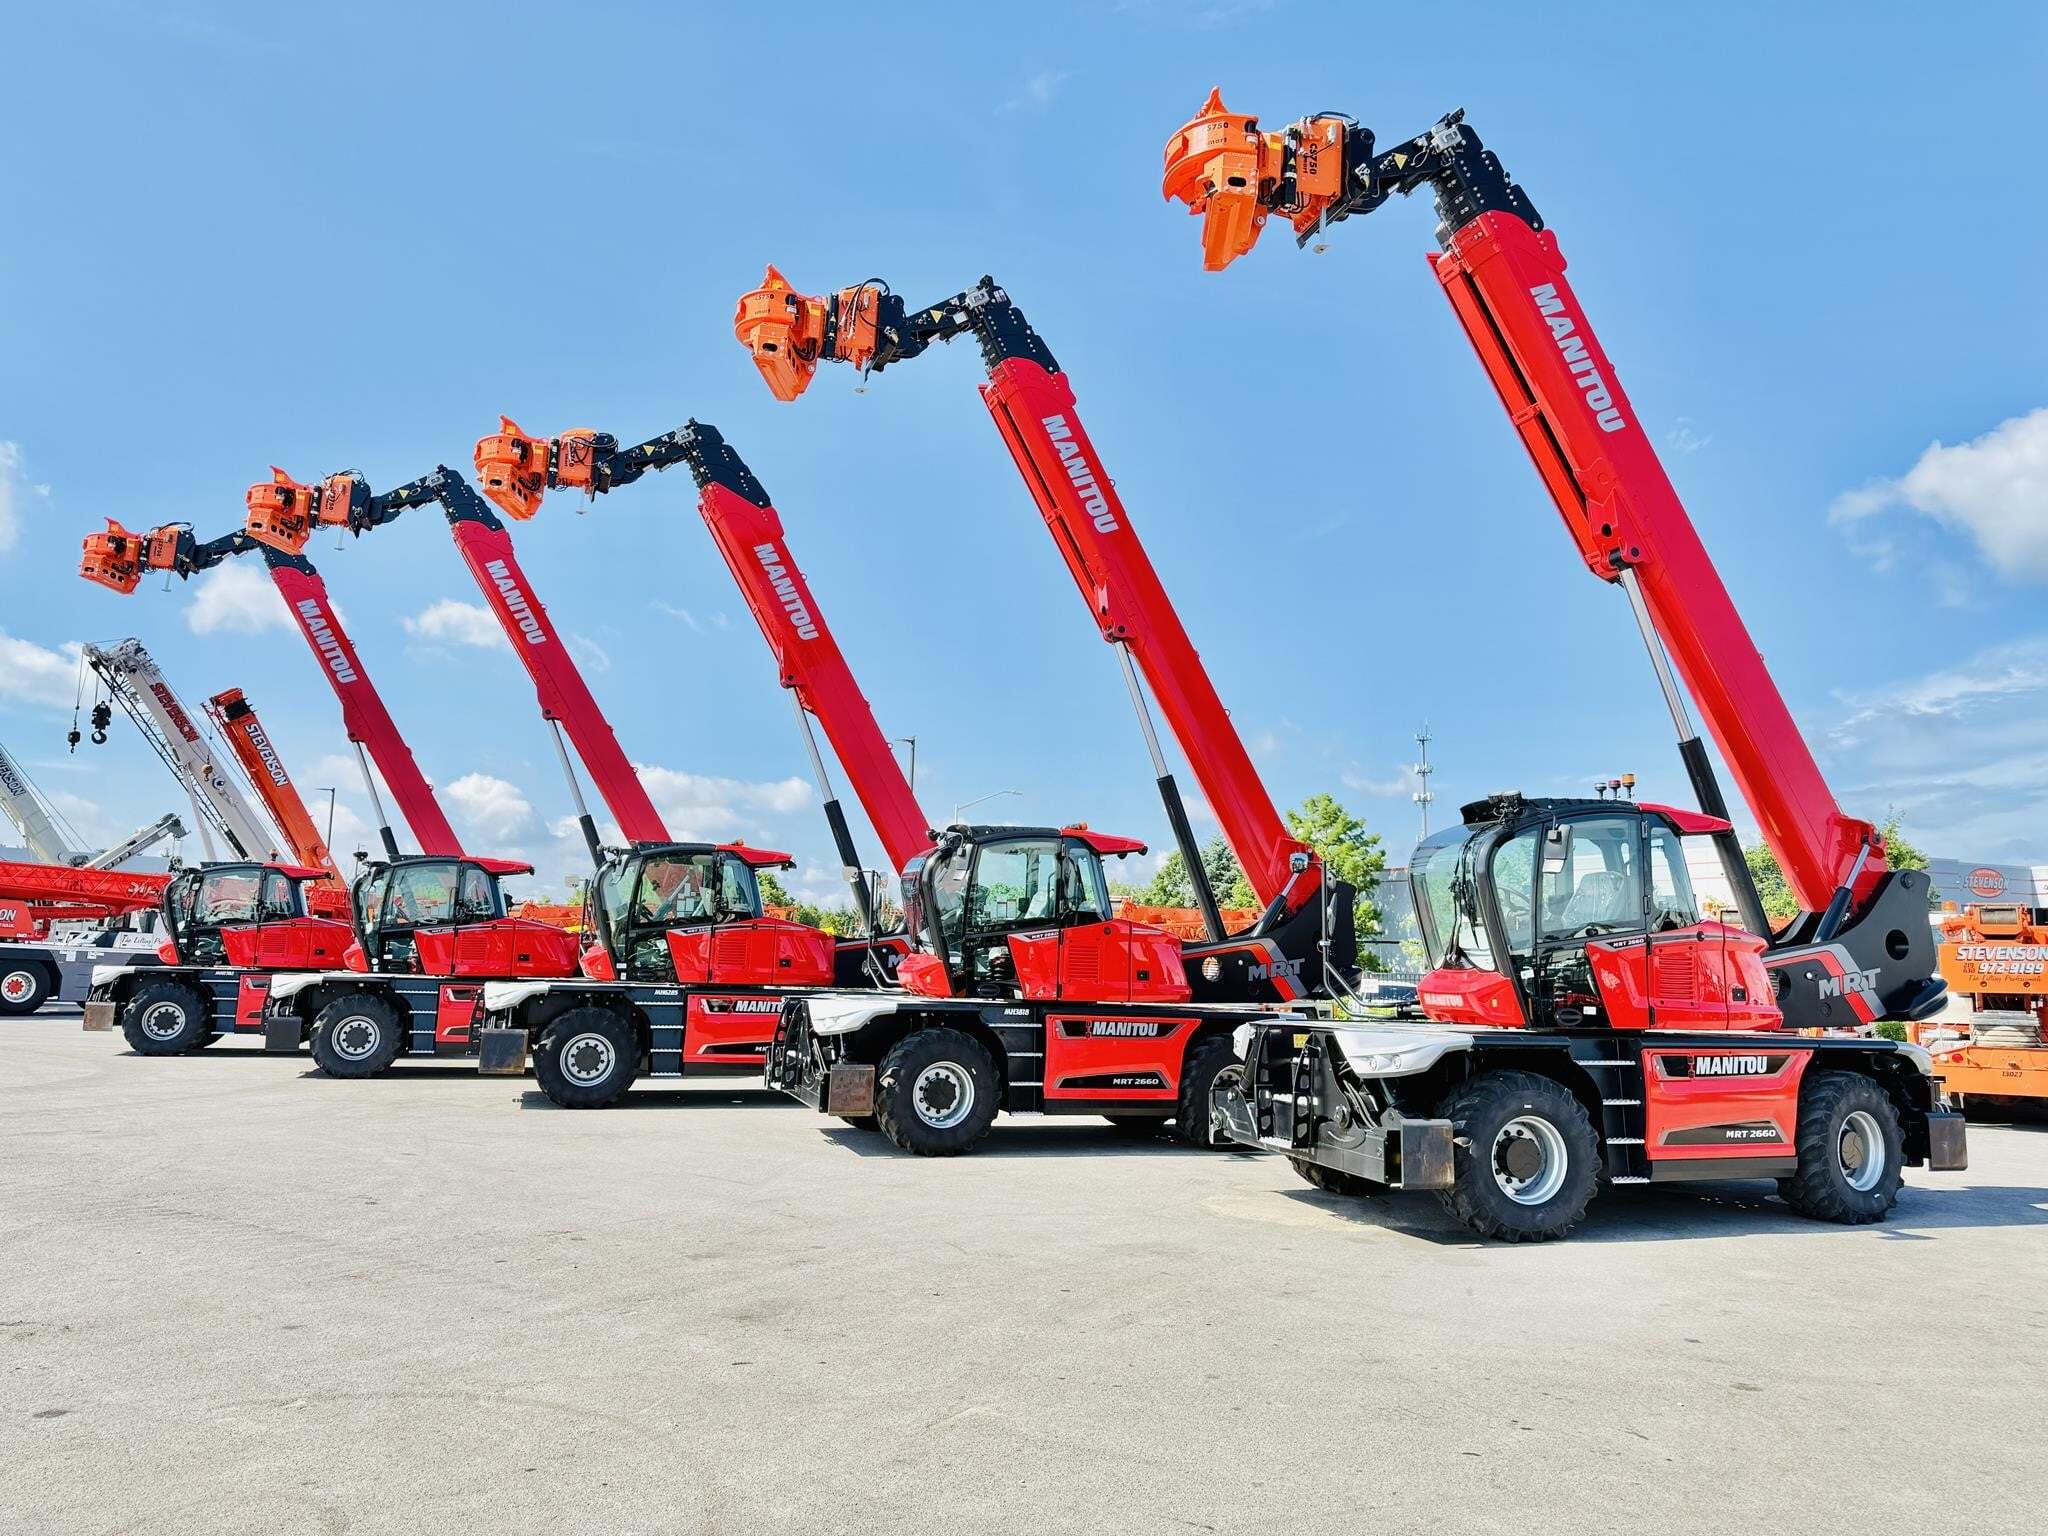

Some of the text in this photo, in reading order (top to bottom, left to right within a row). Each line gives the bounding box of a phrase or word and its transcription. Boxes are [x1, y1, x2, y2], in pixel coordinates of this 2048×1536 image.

[1207, 122, 1229, 131] S750
[1529, 282, 1627, 433] MANITOU
[1041, 413, 1120, 534] MANITOU
[484, 559, 547, 644] MANITOU
[753, 542, 820, 641] MANITOU
[296, 598, 359, 684] MANITOU
[150, 682, 200, 743] STEVENSON
[245, 723, 289, 787] STEVENSON
[1955, 946, 2048, 961] STEVENSON
[1978, 962, 2045, 974] 972-9199
[1248, 958, 1306, 982] MRT
[1818, 967, 1881, 1001] MRT
[735, 1000, 784, 1013] MANITO
[1092, 1021, 1159, 1037] MANITOU
[1695, 1055, 1768, 1075] MANITOU
[1725, 1129, 1777, 1139] MRT 2660
